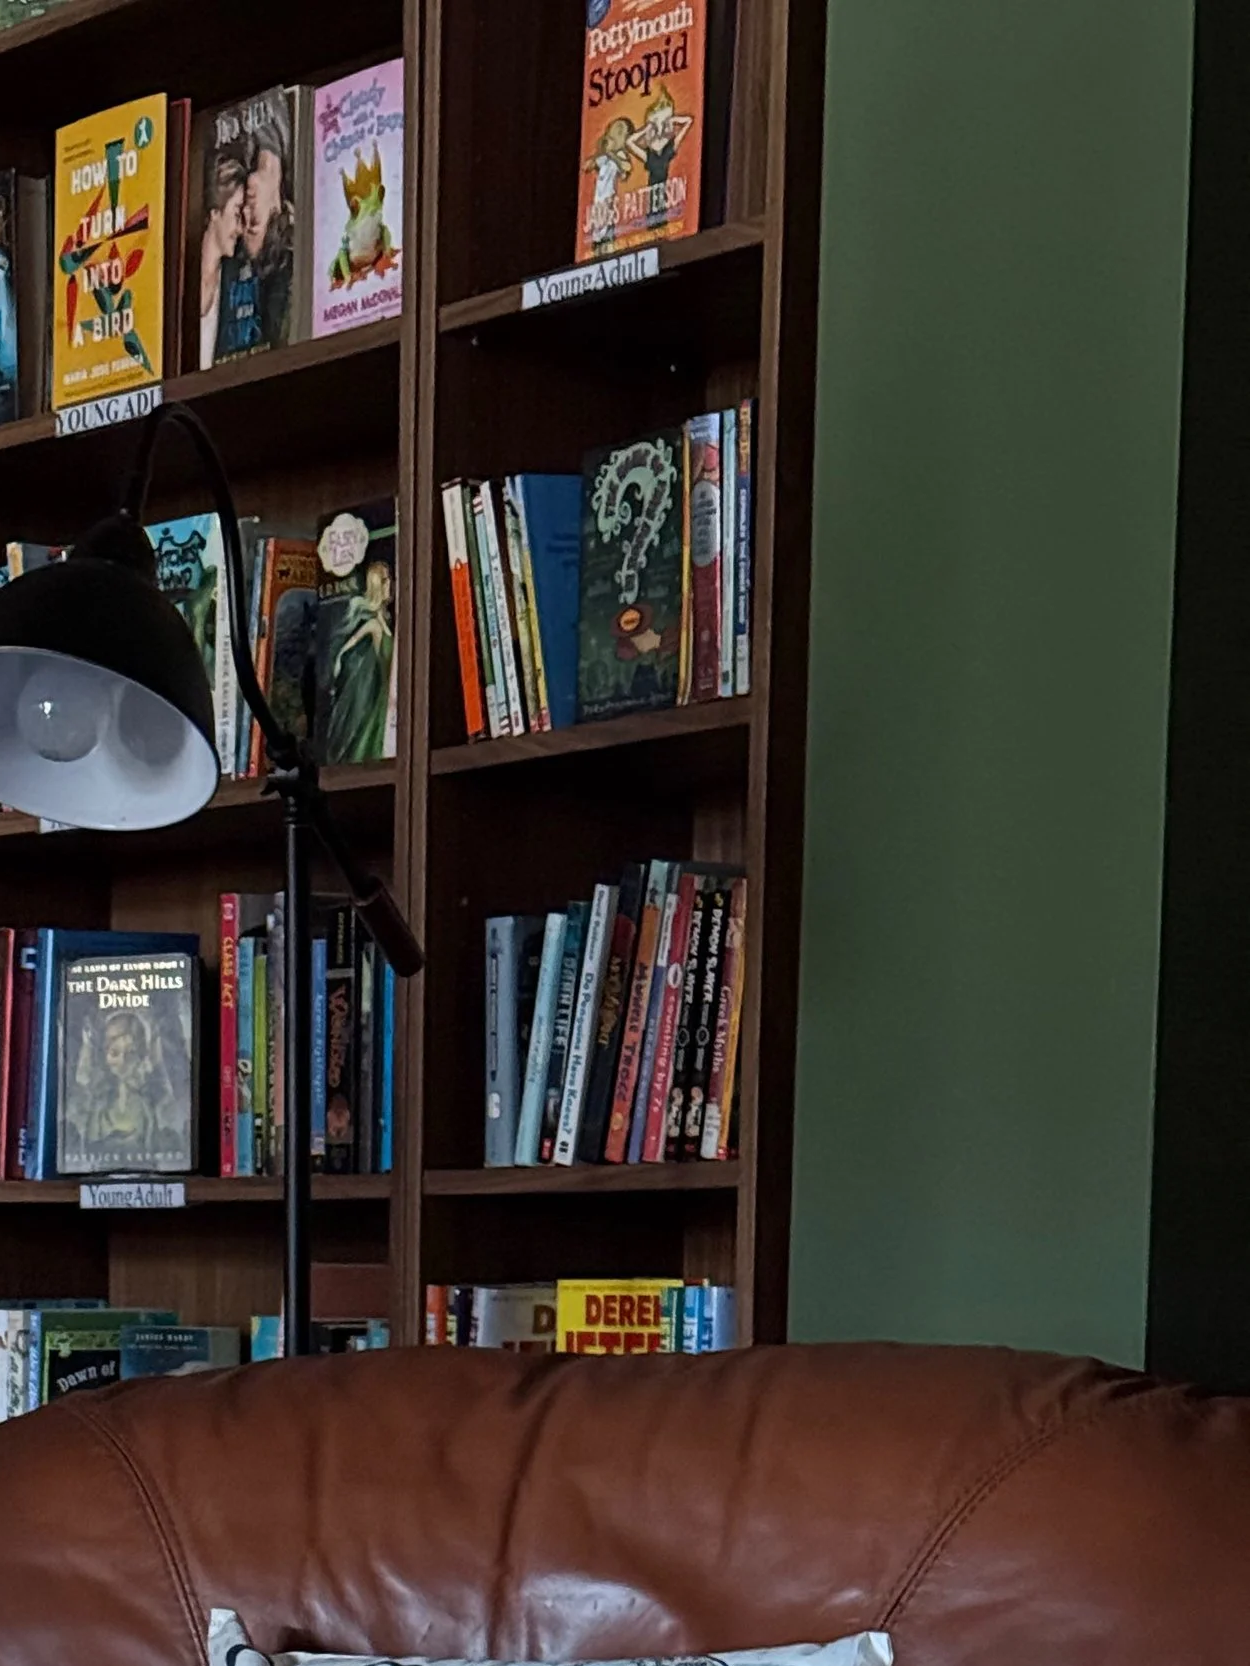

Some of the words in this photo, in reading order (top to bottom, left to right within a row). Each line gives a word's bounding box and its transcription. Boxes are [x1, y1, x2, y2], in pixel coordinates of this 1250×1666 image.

[589, 34, 688, 107] Stoopid
[70, 162, 107, 195] HOW
[118, 149, 139, 178] TO
[79, 204, 127, 241] TURN
[82, 262, 124, 296] INTO
[93, 310, 136, 343] BIRD
[55, 399, 118, 434] YOUNG
[689, 909, 703, 957] DEMON
[706, 907, 724, 956] DEMON
[67, 980, 94, 993] THE
[702, 956, 718, 1004] SLAYER
[711, 1029, 727, 1074] Myths
[56, 1364, 98, 1393] Dawn
